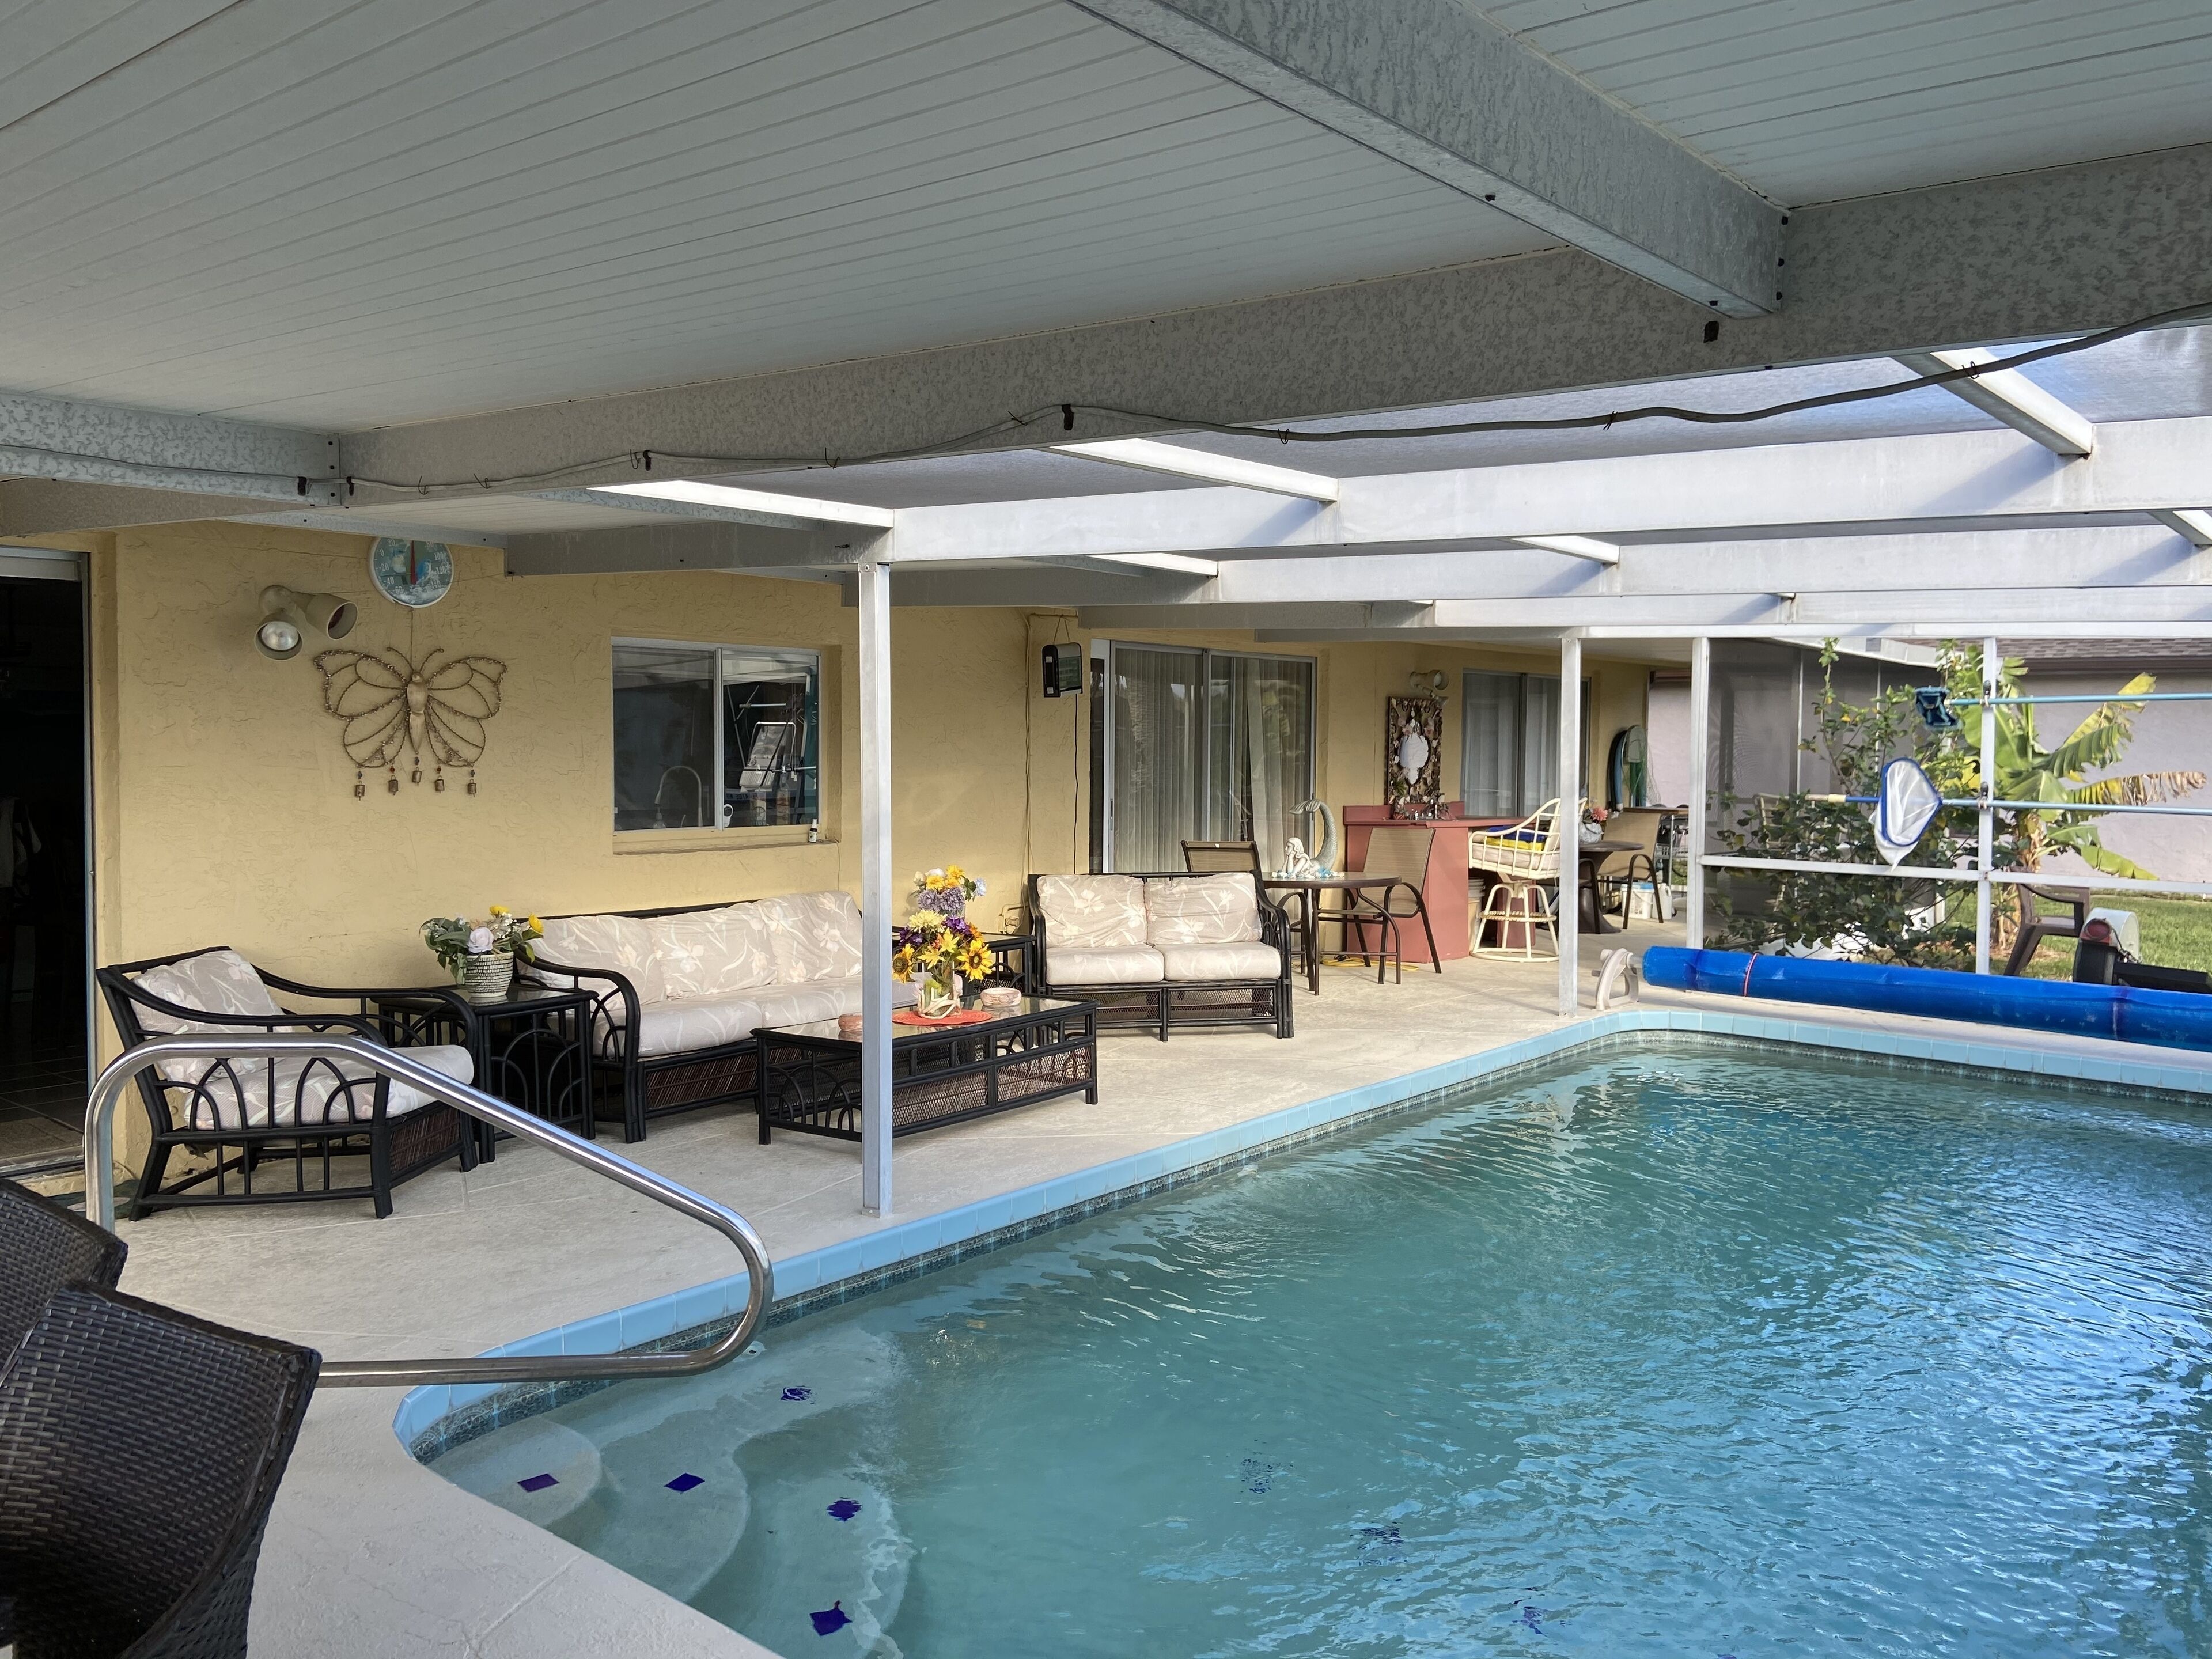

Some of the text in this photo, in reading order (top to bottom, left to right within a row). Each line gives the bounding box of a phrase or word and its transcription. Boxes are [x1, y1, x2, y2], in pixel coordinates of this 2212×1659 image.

[387, 539, 396, 547] 20
[380, 548, 384, 556] 0
[434, 552, 444, 560] 100
[436, 566, 446, 574] 120
